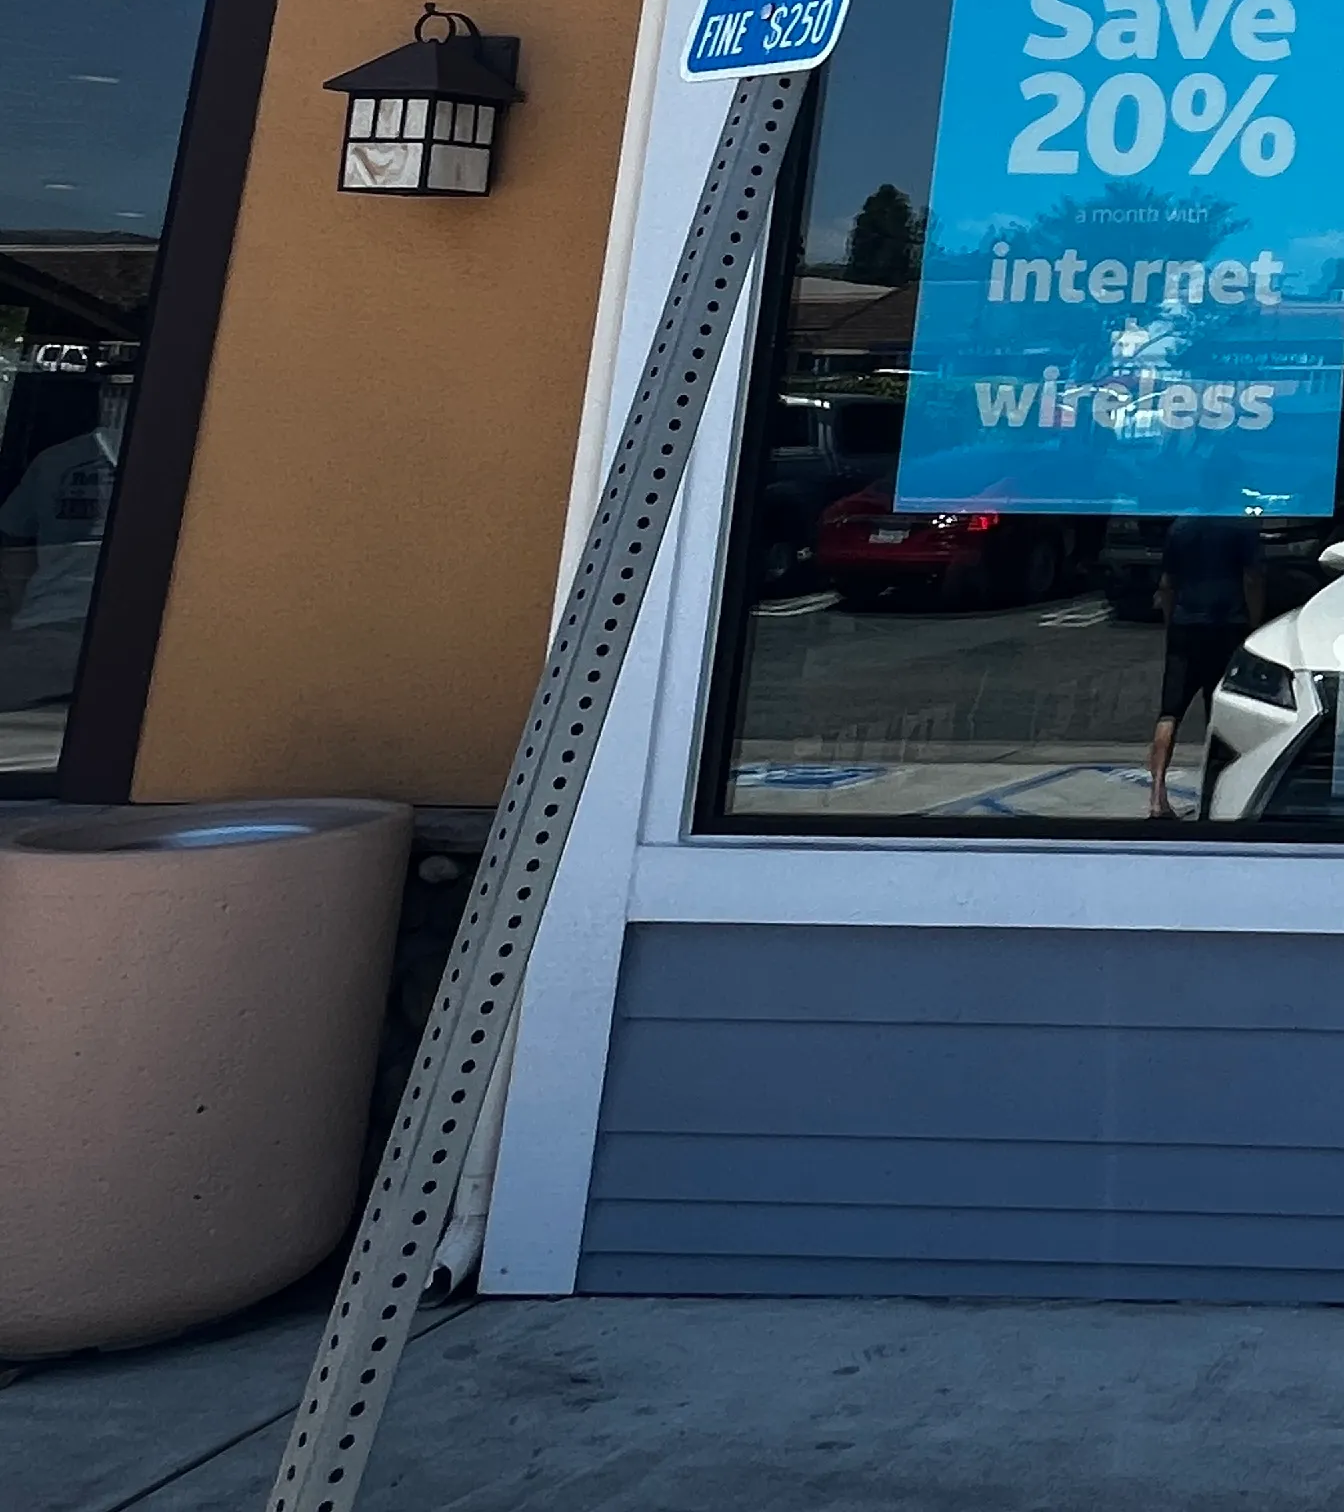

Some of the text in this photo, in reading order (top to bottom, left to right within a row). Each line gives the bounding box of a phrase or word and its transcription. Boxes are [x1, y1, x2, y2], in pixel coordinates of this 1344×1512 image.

[696, 10, 754, 59] FINE
[1007, 71, 1296, 178] 20%
[1075, 203, 1208, 223] a month with
[987, 241, 1283, 305] internet
[974, 365, 1275, 431] wireless
